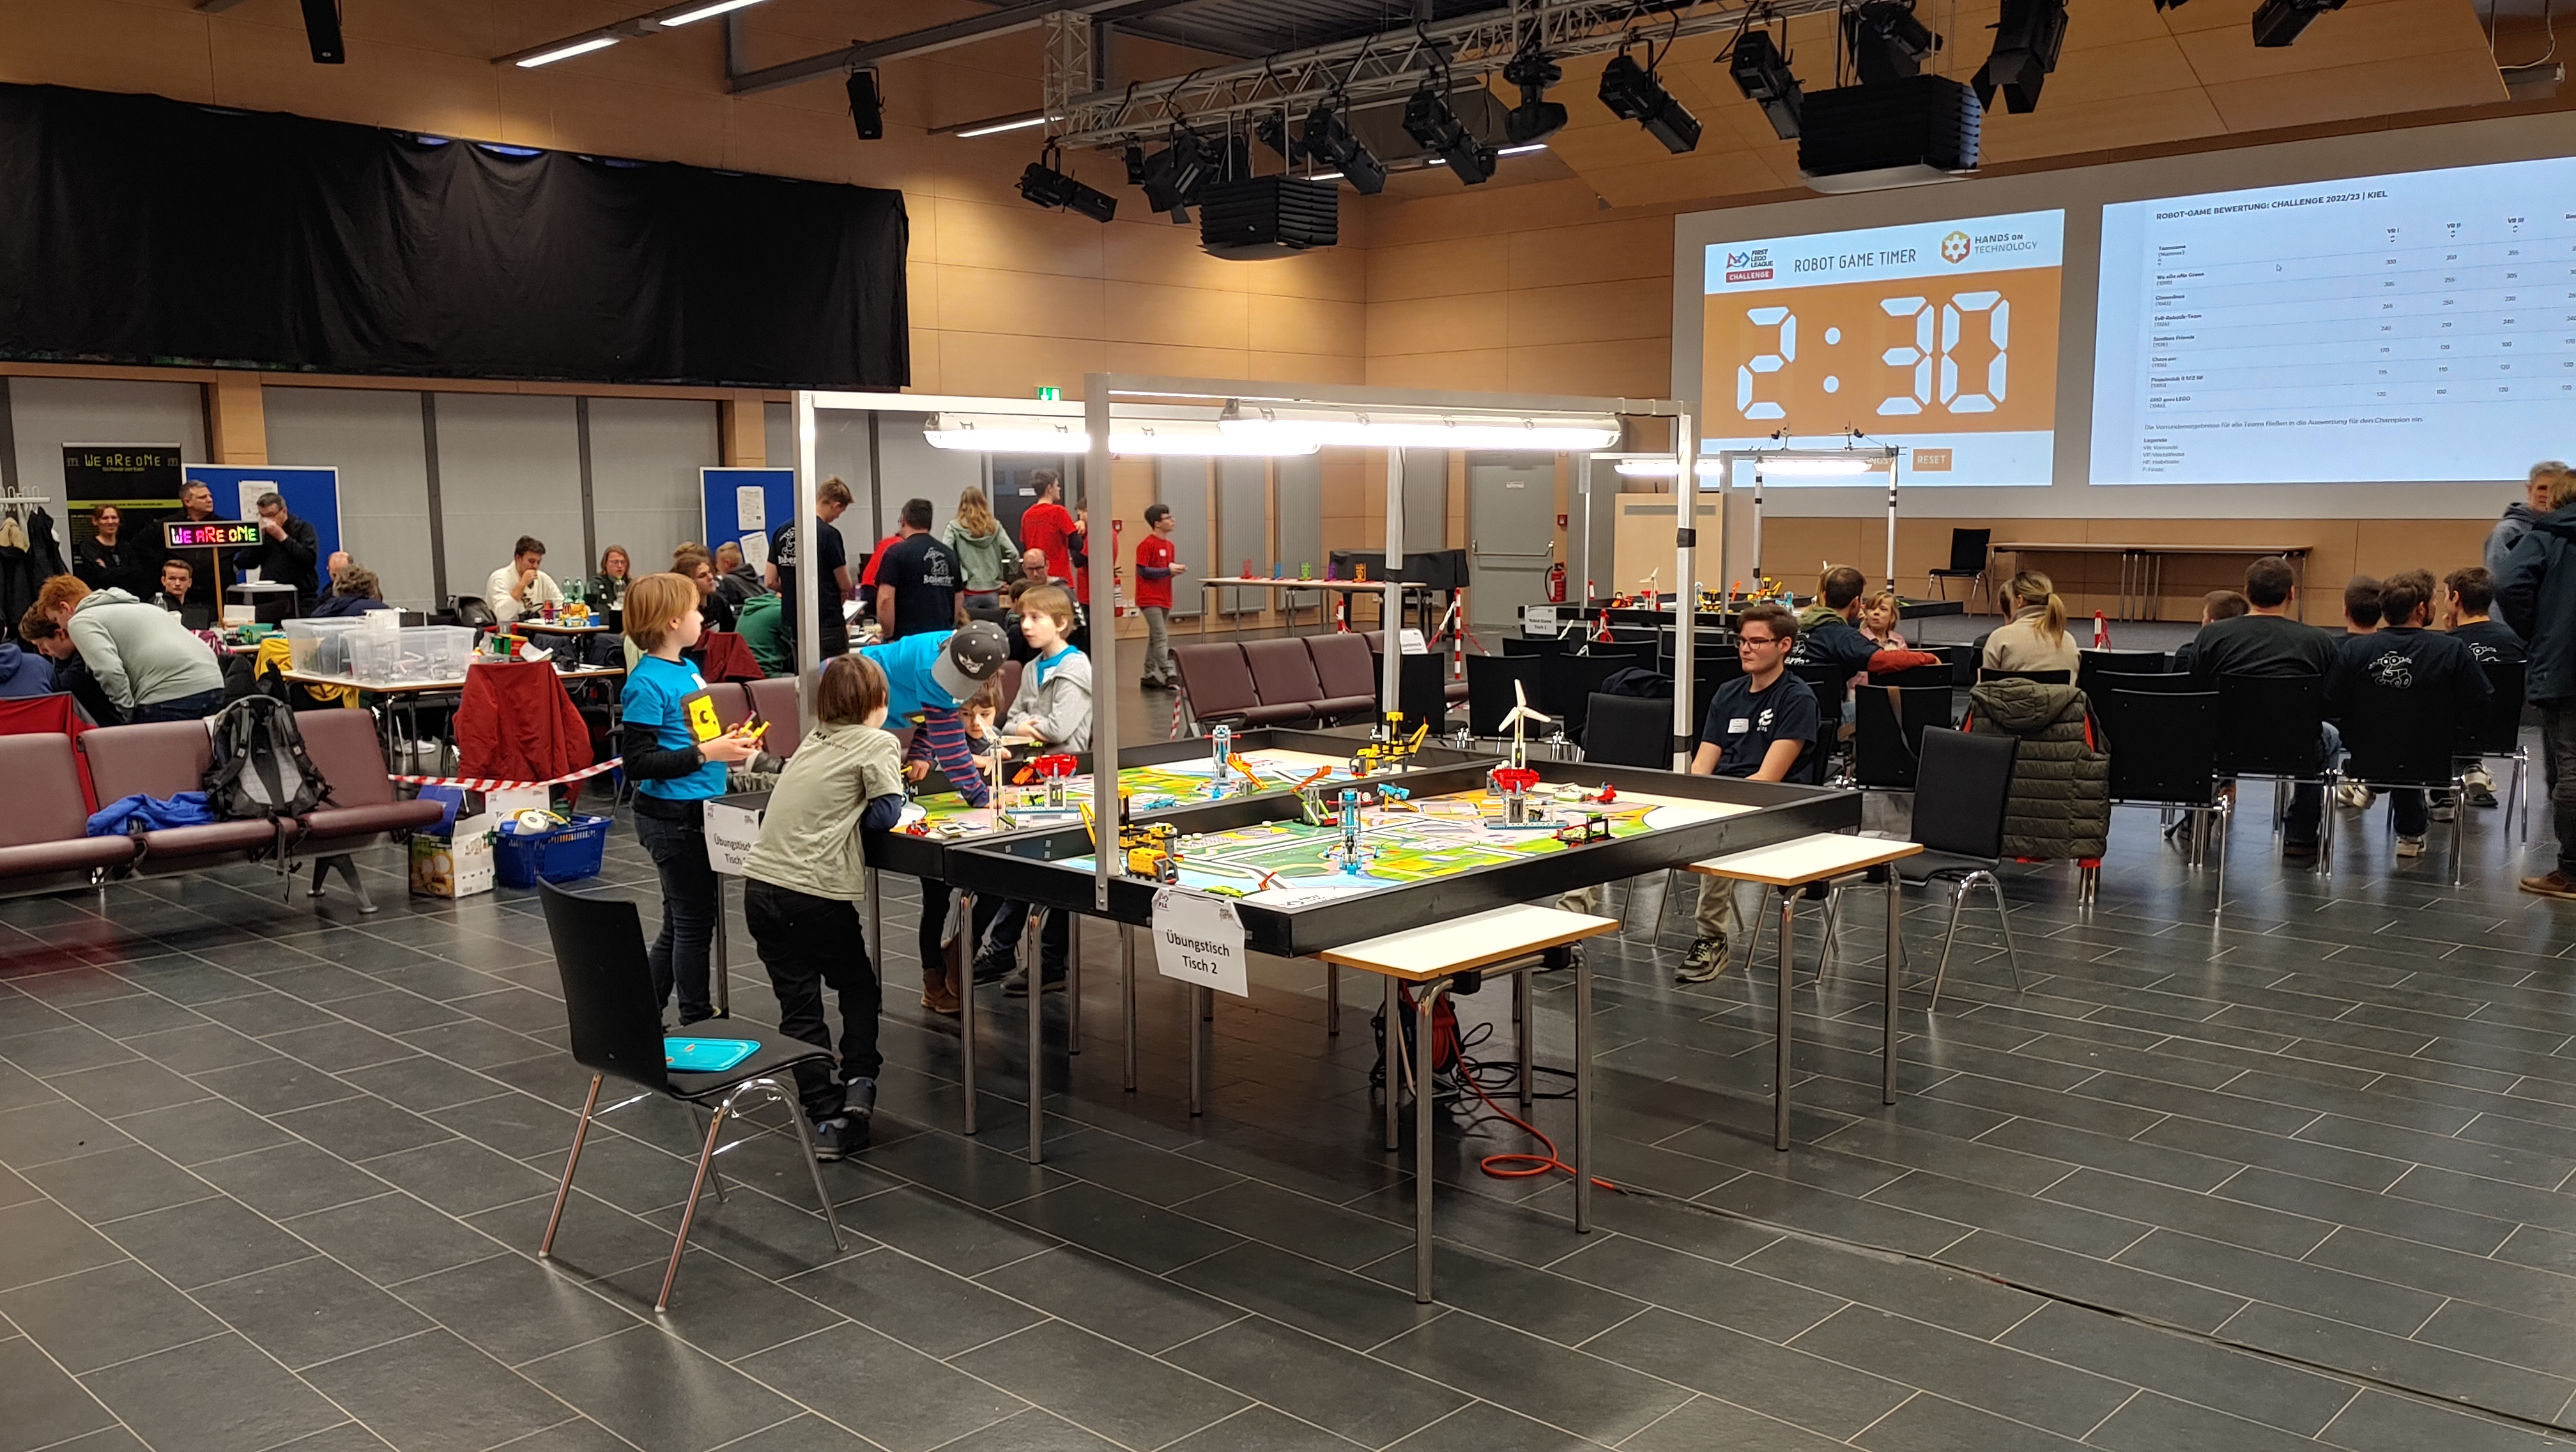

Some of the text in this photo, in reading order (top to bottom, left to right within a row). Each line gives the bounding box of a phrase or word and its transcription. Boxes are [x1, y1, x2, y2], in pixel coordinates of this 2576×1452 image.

[2156, 208, 2212, 220] ROBOT-GAME
[2214, 202, 2269, 215] BEWERTUNG:
[2271, 197, 2324, 208] CHALLENGE
[2326, 192, 2360, 204] 2022/23
[2367, 190, 2388, 199] KIEL
[1975, 233, 2009, 245] HANDS
[1975, 241, 2038, 254] TECHNOLOGY
[1794, 249, 1916, 273] ROBOT GAME TIMER
[1729, 271, 1770, 281] CHALLENGE
[1737, 290, 2010, 420] 2:30
[2374, 416, 2411, 424] Champion
[1917, 454, 1947, 465] RESET
[724, 853, 742, 865] Tisch
[1166, 929, 1230, 957] Übungstisch
[1181, 955, 1218, 975] Tisch 2
